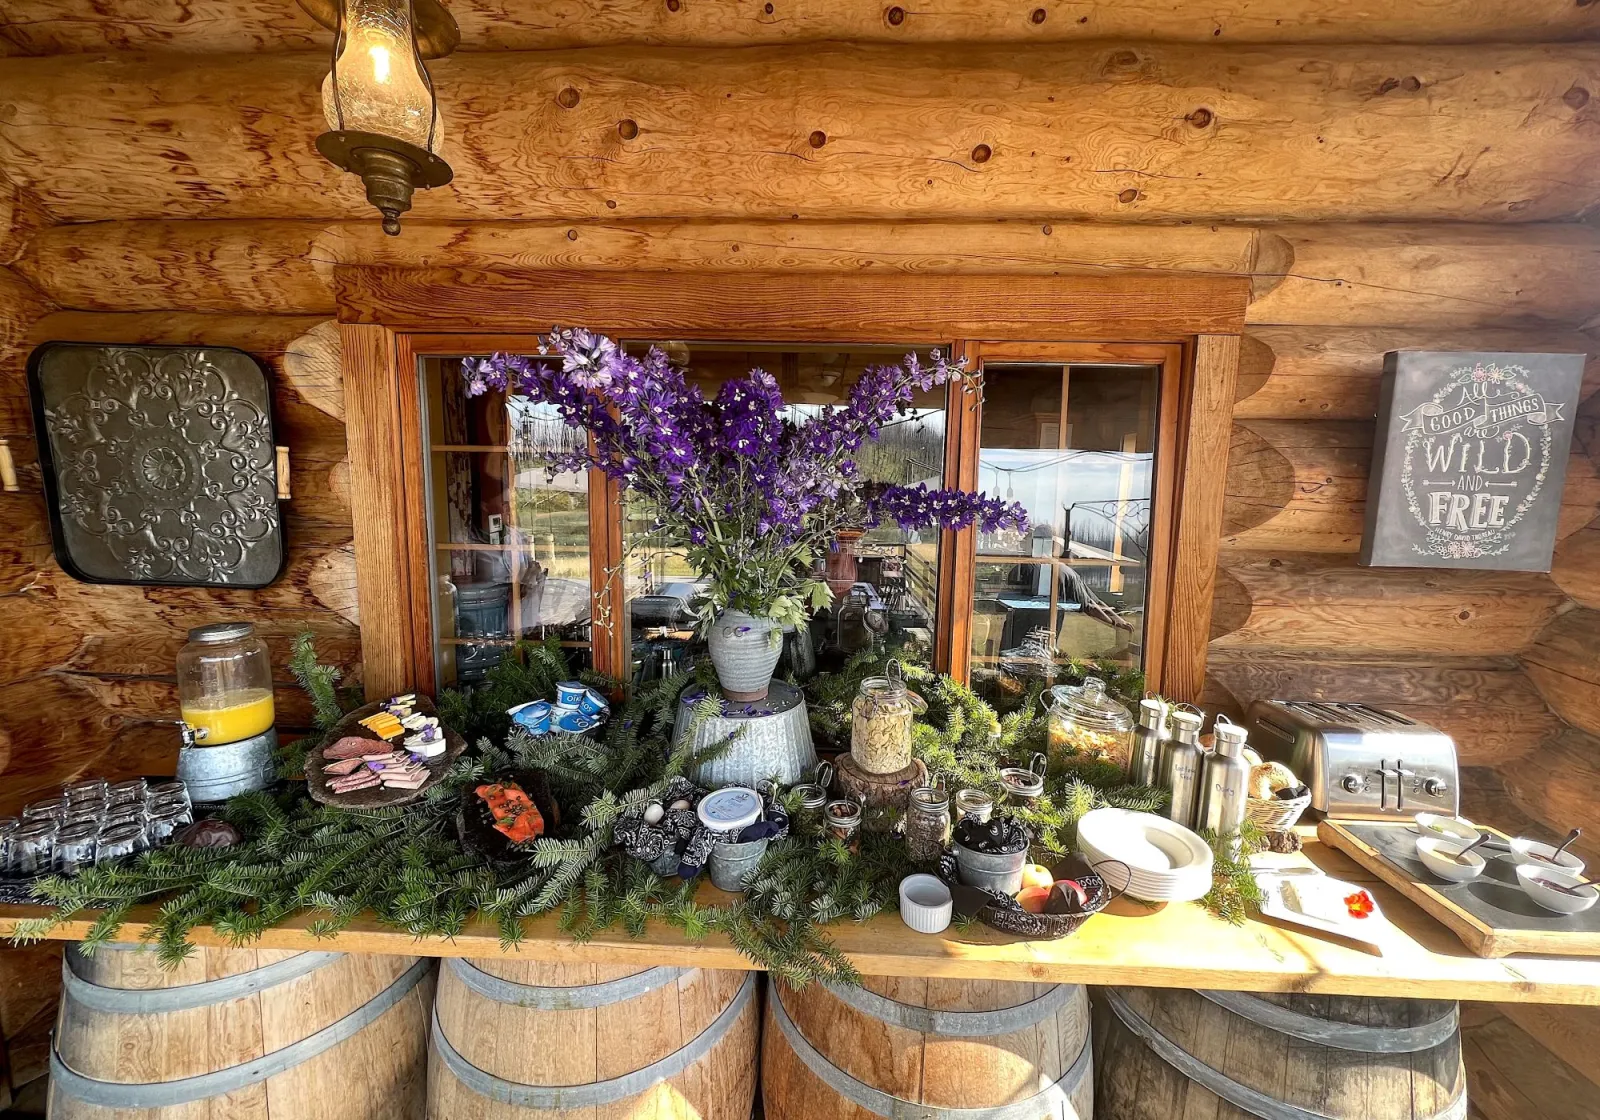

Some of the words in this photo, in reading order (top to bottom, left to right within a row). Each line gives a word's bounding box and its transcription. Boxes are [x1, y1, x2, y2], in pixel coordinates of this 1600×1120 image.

[1456, 382, 1502, 406] All
[1430, 407, 1475, 431] GOOD
[1489, 398, 1539, 422] THINGS
[1463, 425, 1500, 439] are
[1422, 431, 1531, 474] WILD
[1457, 475, 1483, 491] AND
[1428, 491, 1510, 533] FREE
[1434, 527, 1453, 538] HENRY
[1453, 533, 1471, 541] DAVID
